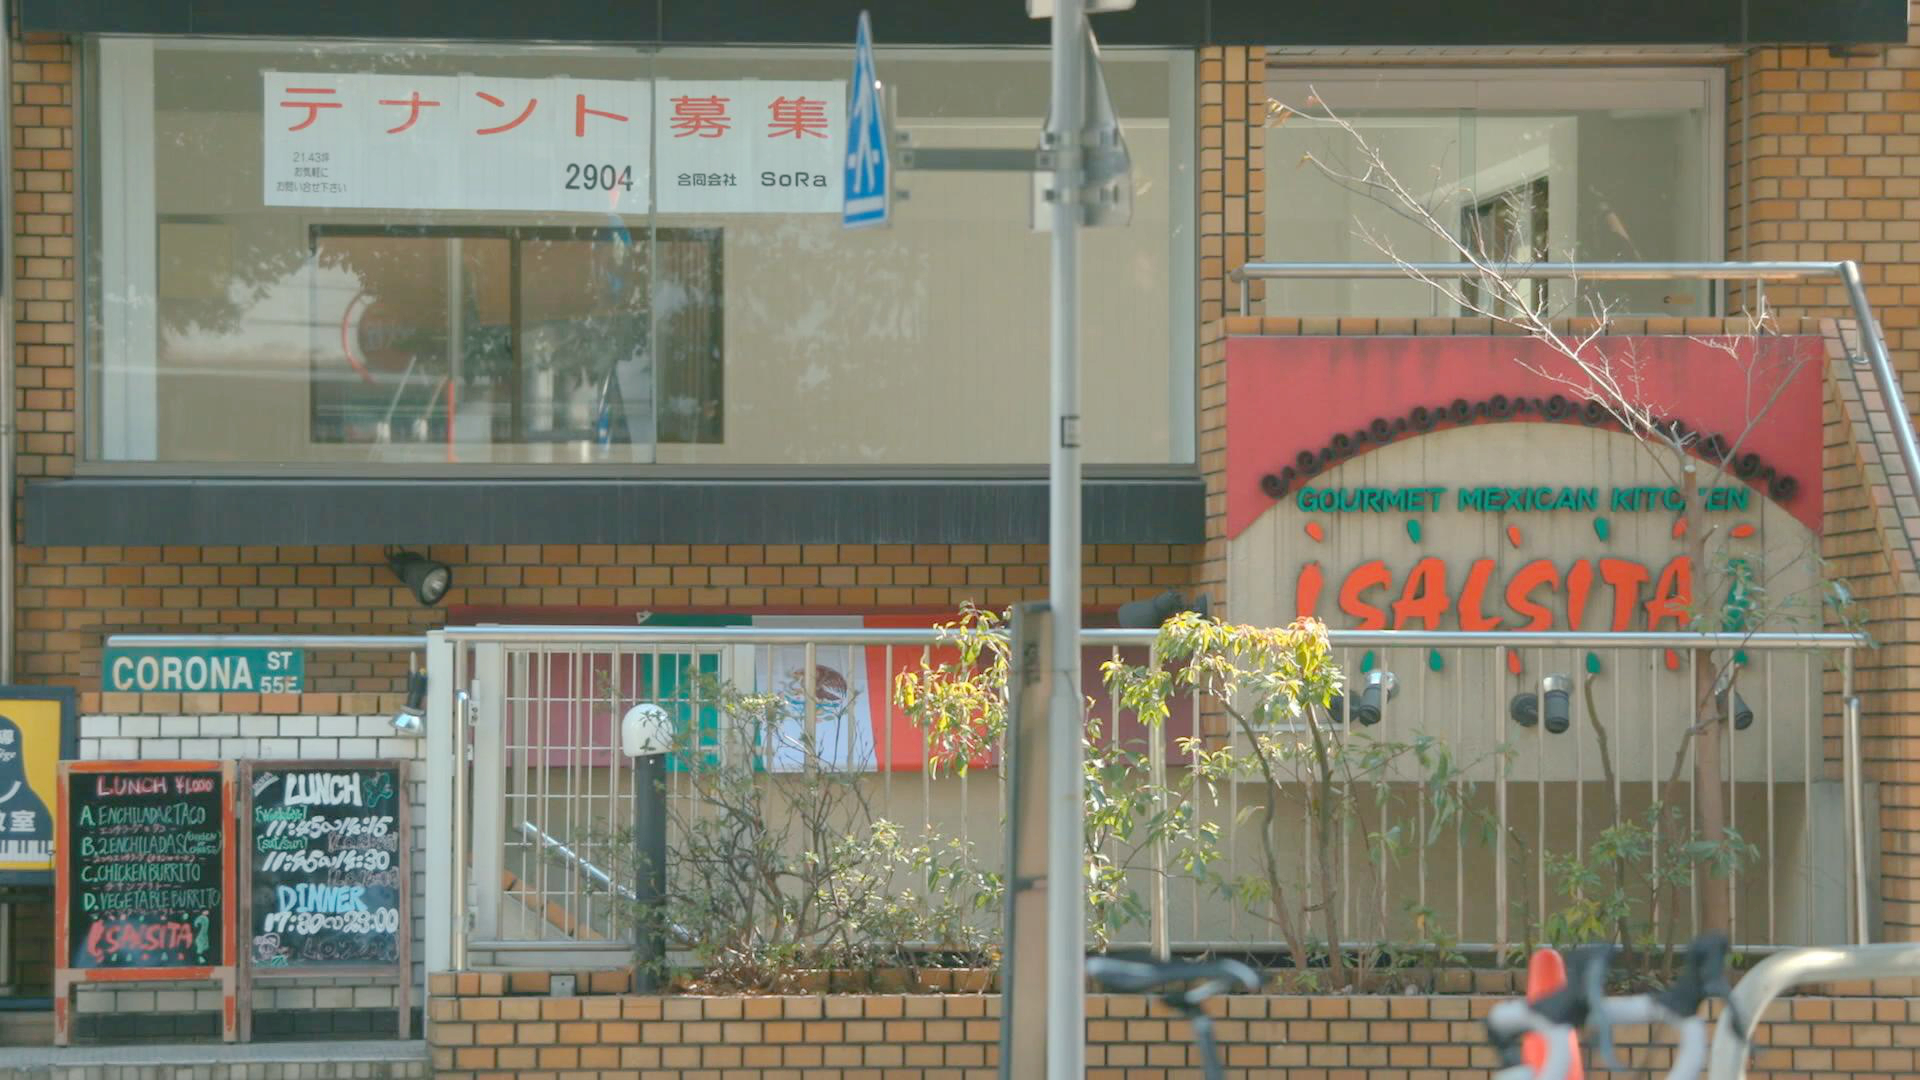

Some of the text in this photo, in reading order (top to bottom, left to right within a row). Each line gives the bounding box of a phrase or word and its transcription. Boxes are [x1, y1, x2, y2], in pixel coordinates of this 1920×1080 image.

[279, 88, 830, 139] テナント 募集
[564, 163, 634, 191] 2904
[677, 171, 828, 187] 合同会社 SoRa
[1296, 487, 1750, 513] GOURMET MEXICAN KITCEN
[112, 651, 293, 691] CORONA ST
[96, 776, 168, 796] LUNCH
[284, 772, 362, 806] LUNCH
[278, 884, 368, 912] DINNER
